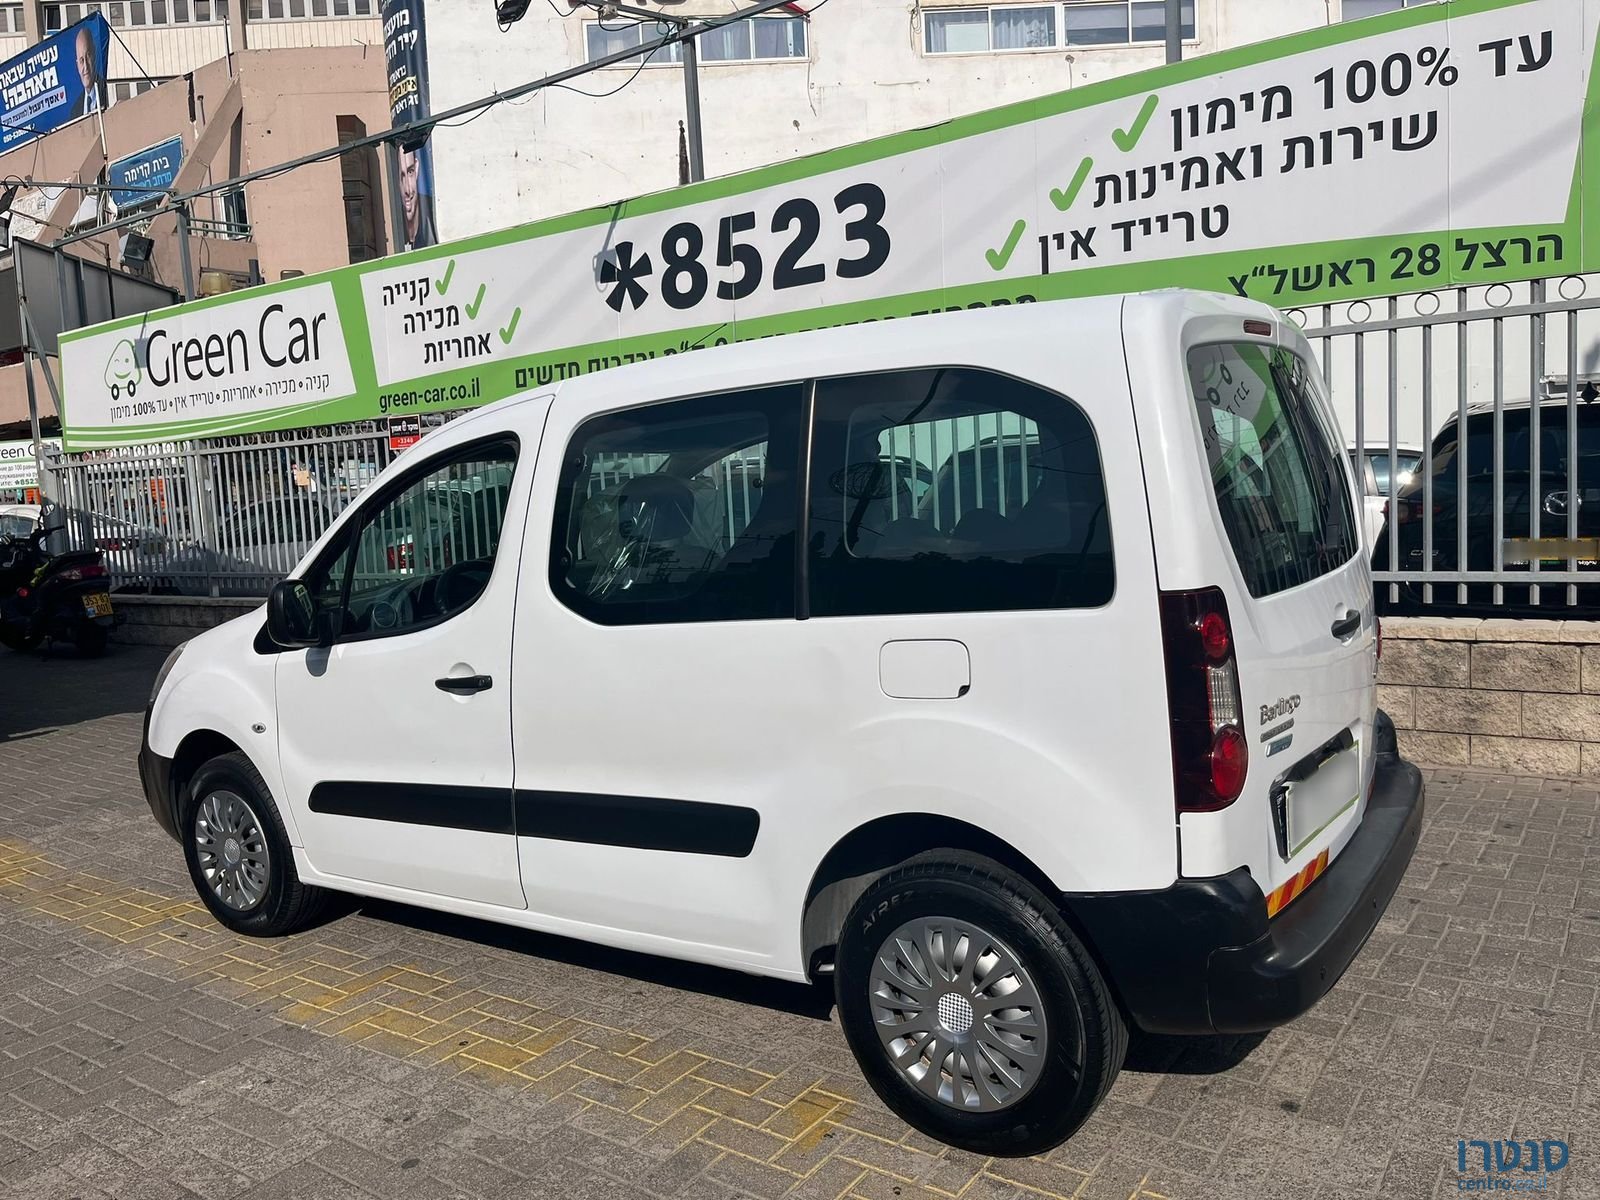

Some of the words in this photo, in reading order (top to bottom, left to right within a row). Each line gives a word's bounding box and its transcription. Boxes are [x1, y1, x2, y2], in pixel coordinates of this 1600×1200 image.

[27, 44, 59, 73] עשייה
[1479, 30, 1553, 77] עד
[2, 65, 59, 110] מאהבה!
[1314, 46, 1459, 112] 100%
[1171, 84, 1293, 151] מימון
[1280, 110, 1438, 175] שירות
[124, 162, 151, 183] קדימה
[153, 156, 170, 173] בית
[1093, 143, 1264, 209] ואמינות
[1111, 204, 1230, 253] טרייד
[1038, 226, 1097, 275] אין
[1390, 243, 1441, 280] 28
[1454, 233, 1563, 271] הרצל
[382, 277, 431, 306] קנייה
[404, 305, 460, 334] מכירה
[146, 329, 249, 387] Green
[258, 304, 326, 367] Car
[424, 333, 492, 364] אחריות
[265, 379, 296, 397] מכירה
[305, 373, 330, 392] קניה
[515, 361, 580, 389] חדשים
[133, 400, 155, 416] 100%
[157, 399, 168, 411] עד
[174, 396, 188, 413] אין
[189, 393, 214, 407] טרייד
[222, 385, 257, 403] אחריות
[379, 377, 480, 413] green-car.co.il
[110, 404, 131, 423] מימון
[0, 447, 25, 459] een
